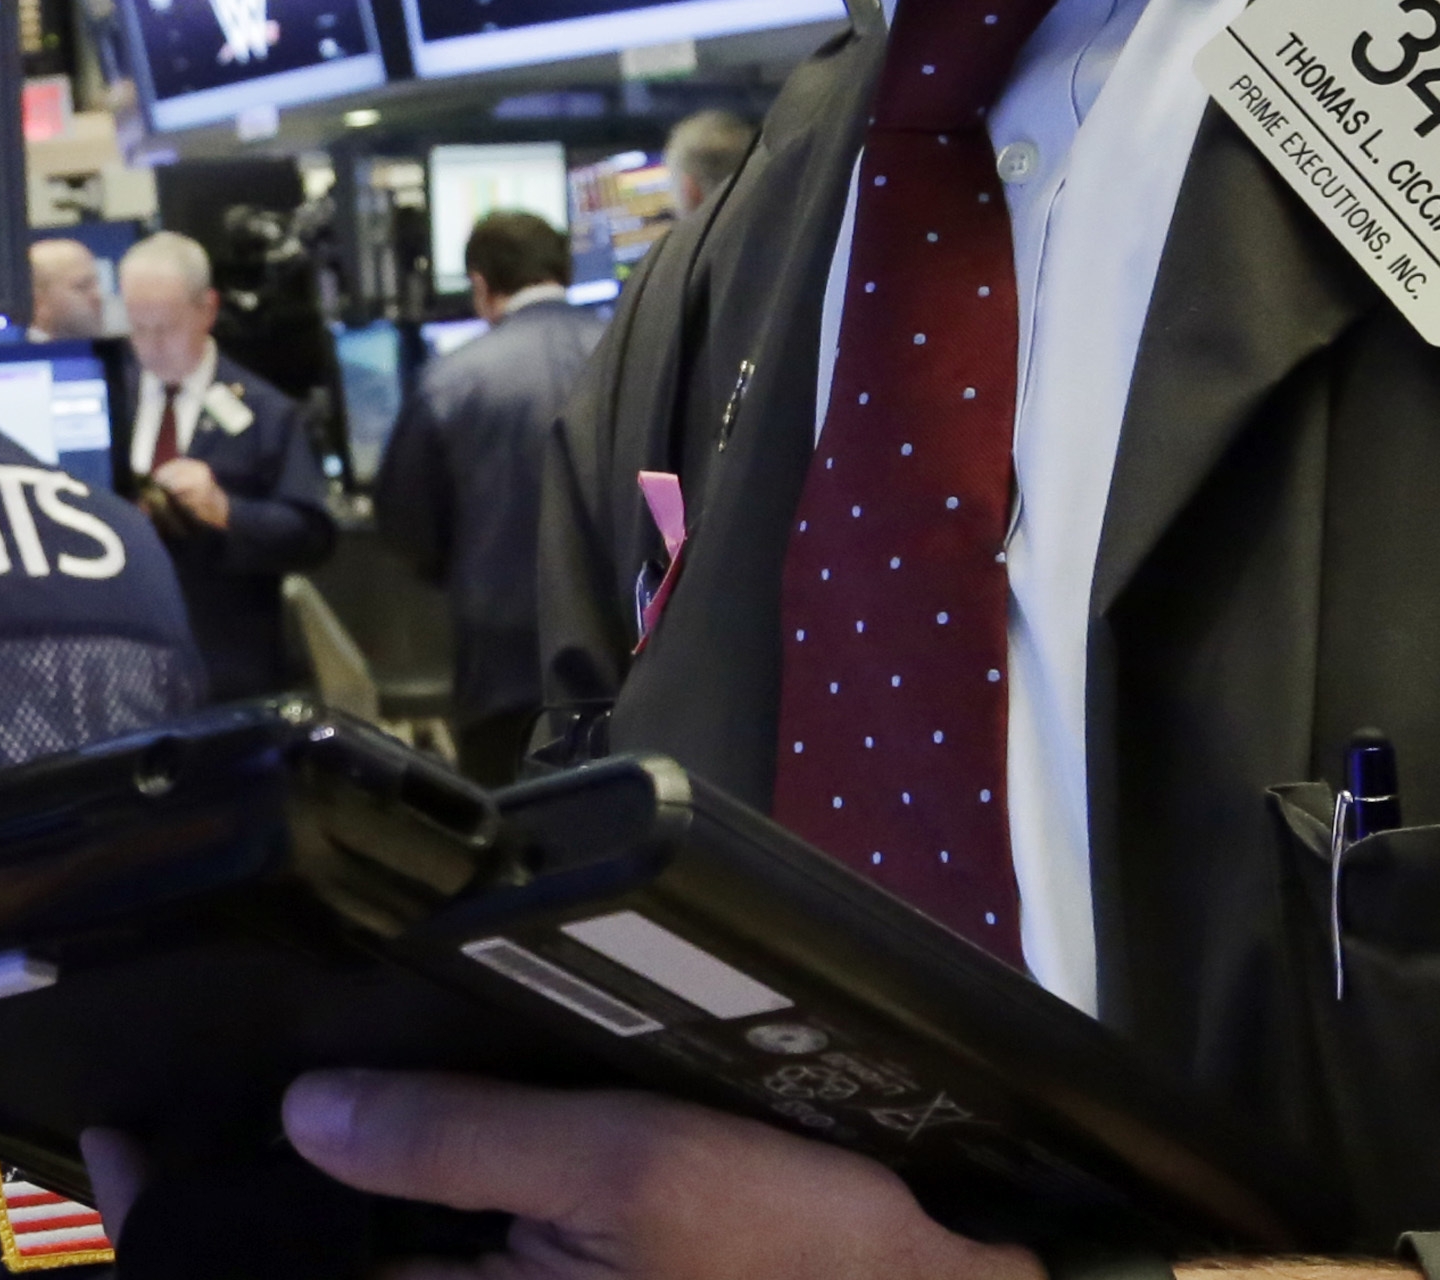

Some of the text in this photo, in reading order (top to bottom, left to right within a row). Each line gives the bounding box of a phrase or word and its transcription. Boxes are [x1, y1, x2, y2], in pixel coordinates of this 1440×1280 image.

[1229, 74, 1427, 300] PRIME EXECUTIONS, INC.
[1276, 32, 1370, 135] THOMAS
[1359, 128, 1384, 164] L.
